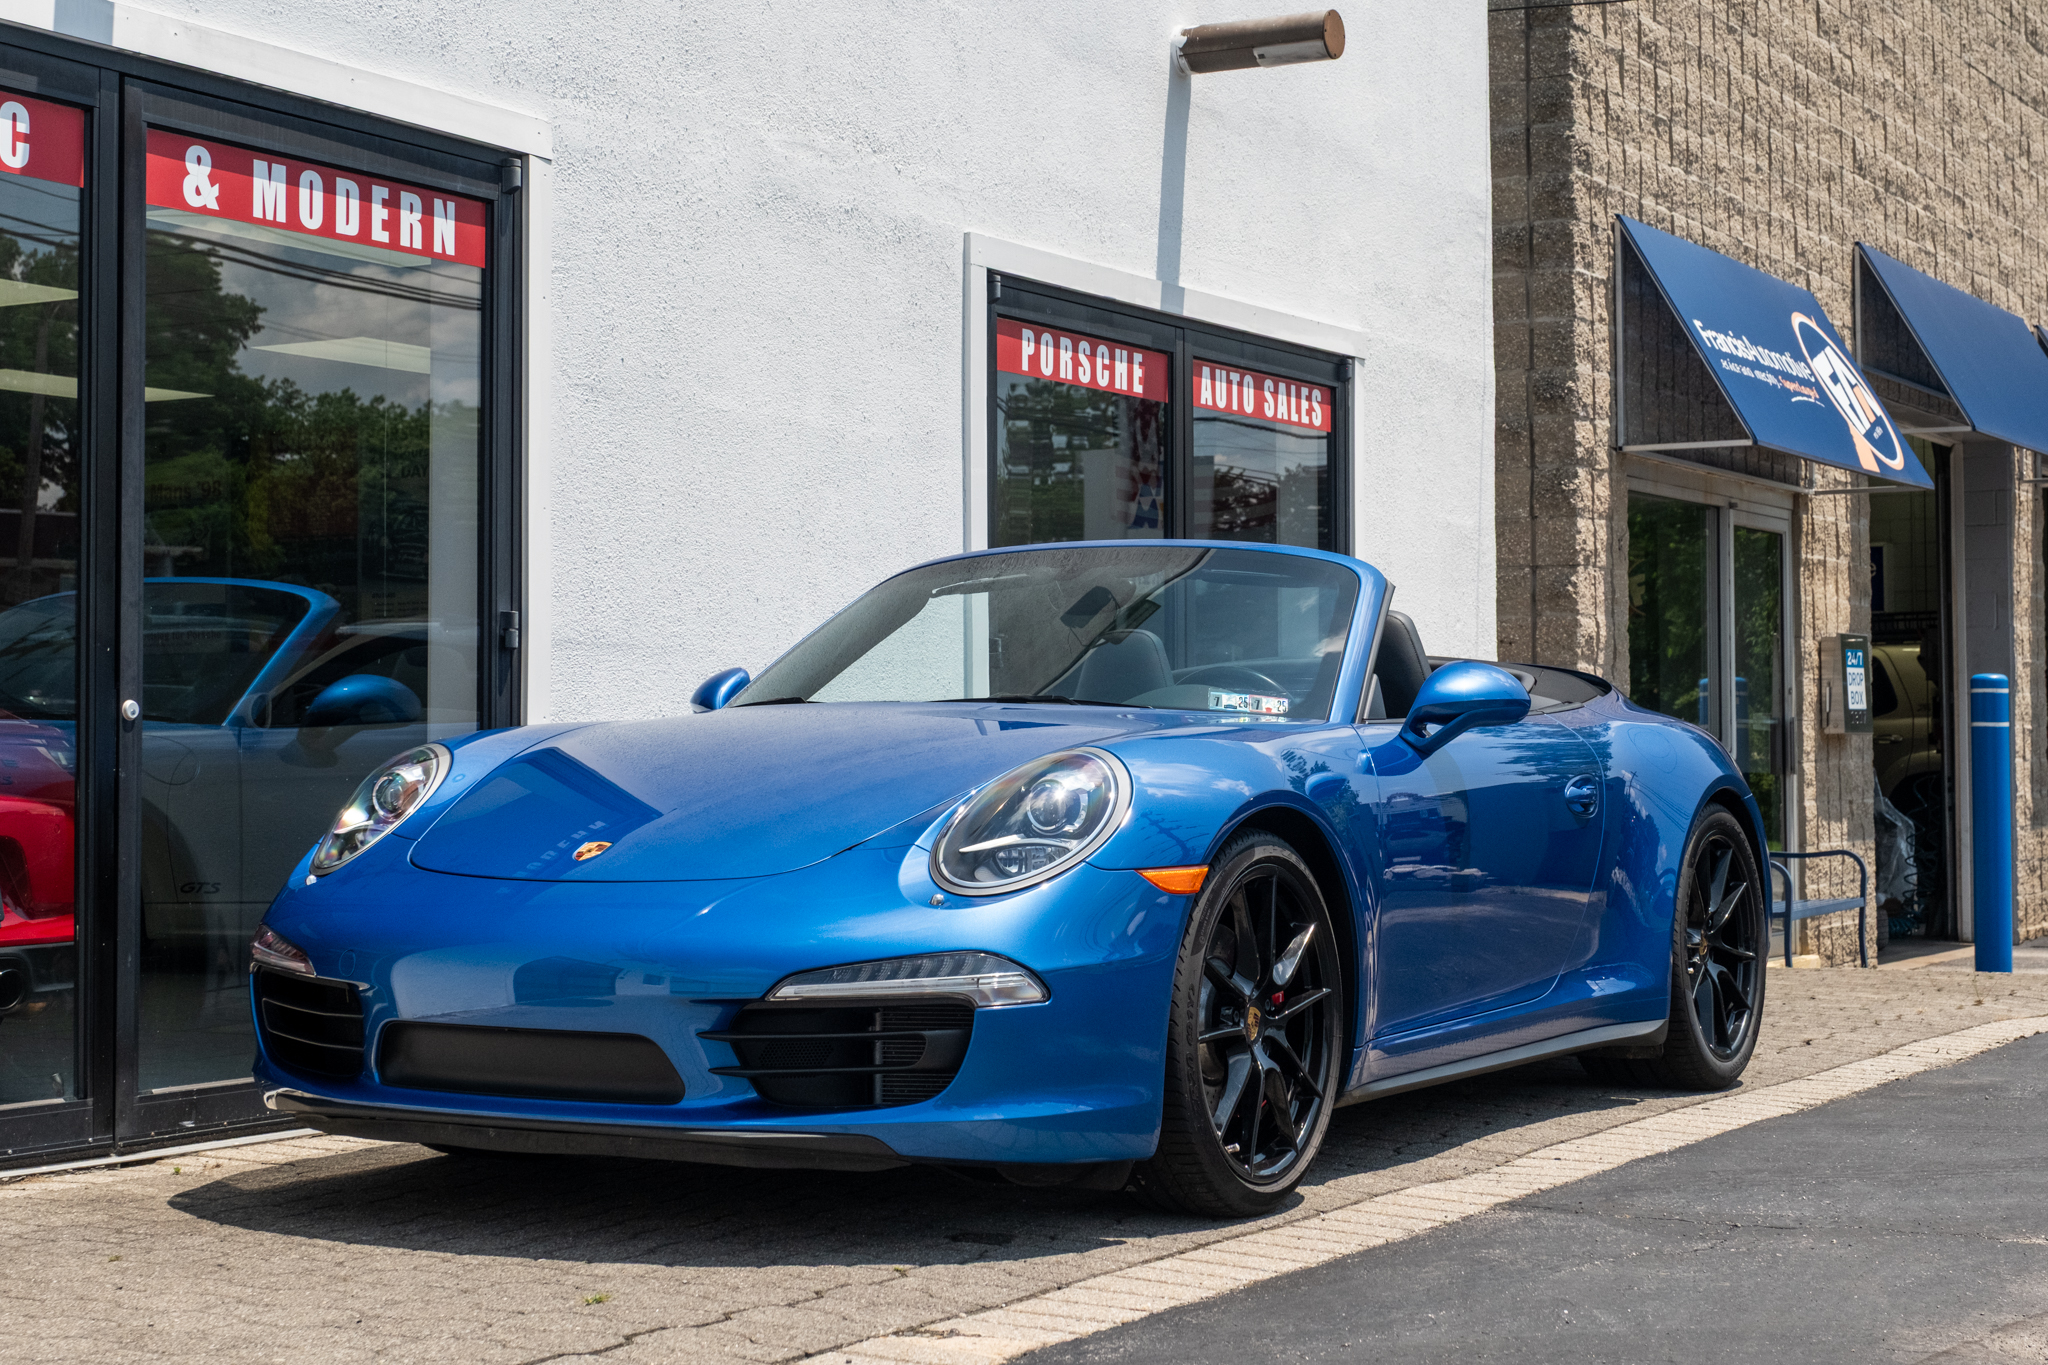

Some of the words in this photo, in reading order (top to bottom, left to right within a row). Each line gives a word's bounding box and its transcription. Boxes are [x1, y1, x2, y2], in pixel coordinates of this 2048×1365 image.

[182, 145, 220, 210] &
[252, 158, 456, 256] MODERN
[1021, 328, 1143, 394] PORSCHE
[1200, 366, 1254, 414] AUTO
[1263, 378, 1322, 427] SALES
[1847, 651, 1863, 666] 24/7
[1848, 672, 1863, 686] DROP
[1238, 696, 1248, 709] 25
[1850, 690, 1864, 705] BOX
[180, 881, 221, 894] GTS
